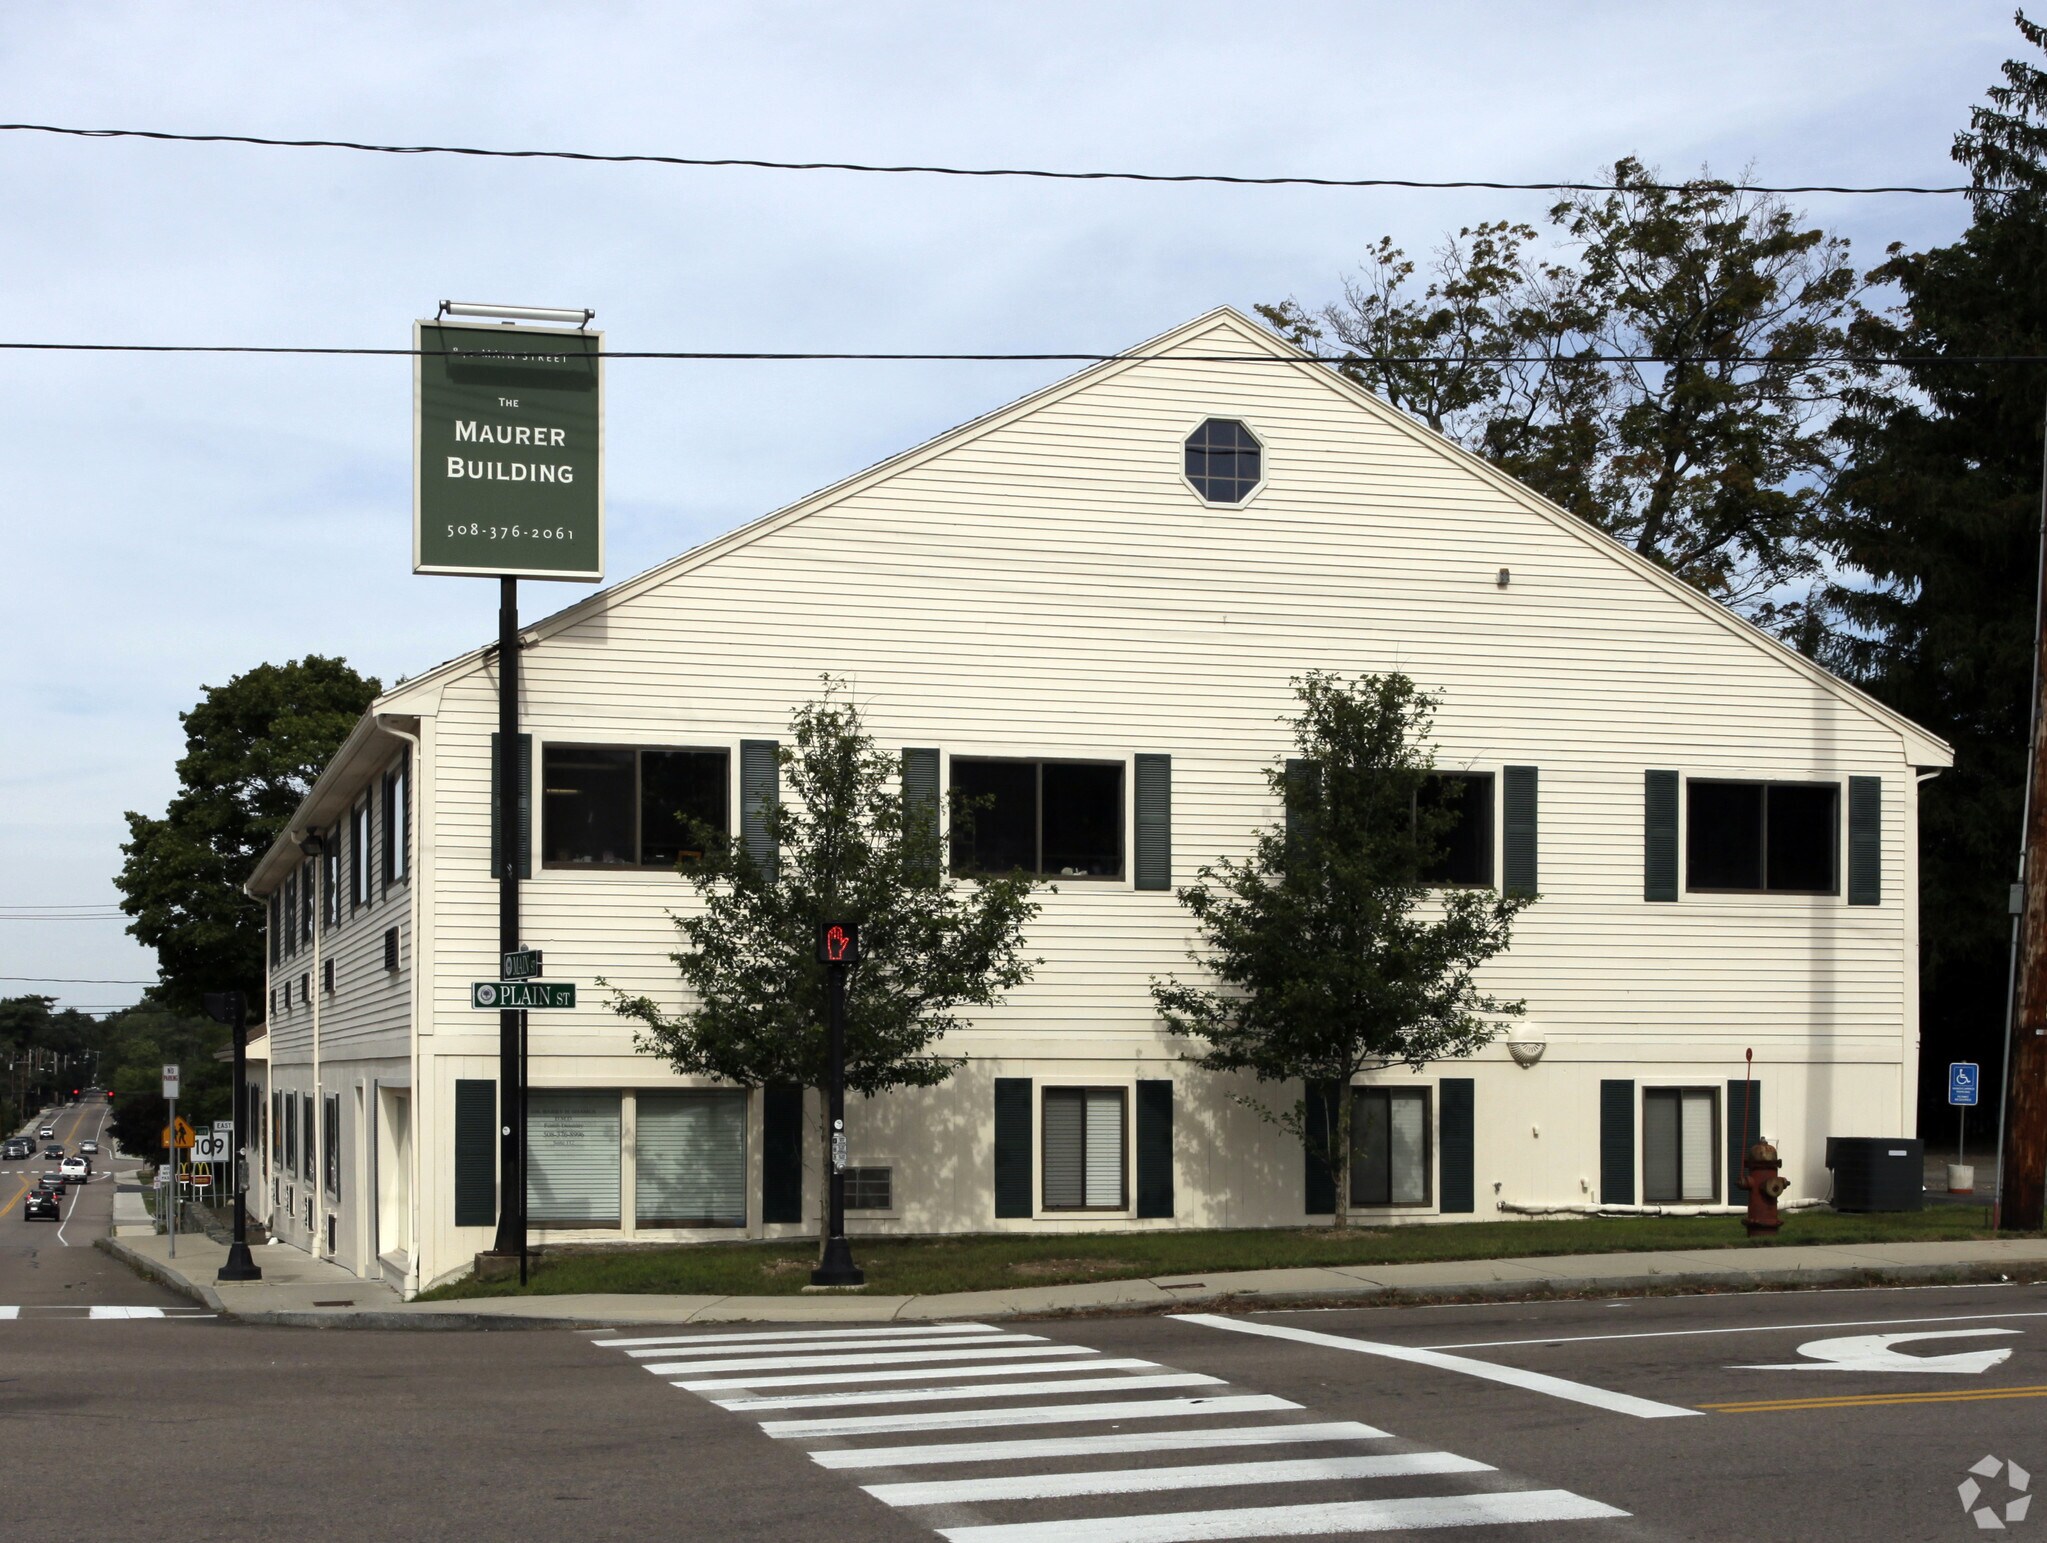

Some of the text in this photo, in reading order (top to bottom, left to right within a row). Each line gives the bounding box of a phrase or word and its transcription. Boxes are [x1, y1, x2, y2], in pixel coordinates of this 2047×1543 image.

[498, 397, 519, 408] THE
[455, 420, 566, 447] MAURER
[447, 456, 574, 484] BUILDING
[447, 523, 574, 540] 508-376-2061
[512, 955, 530, 975] MAIN
[500, 985, 571, 1006] PLAIN ST
[195, 1138, 224, 1155] 109
